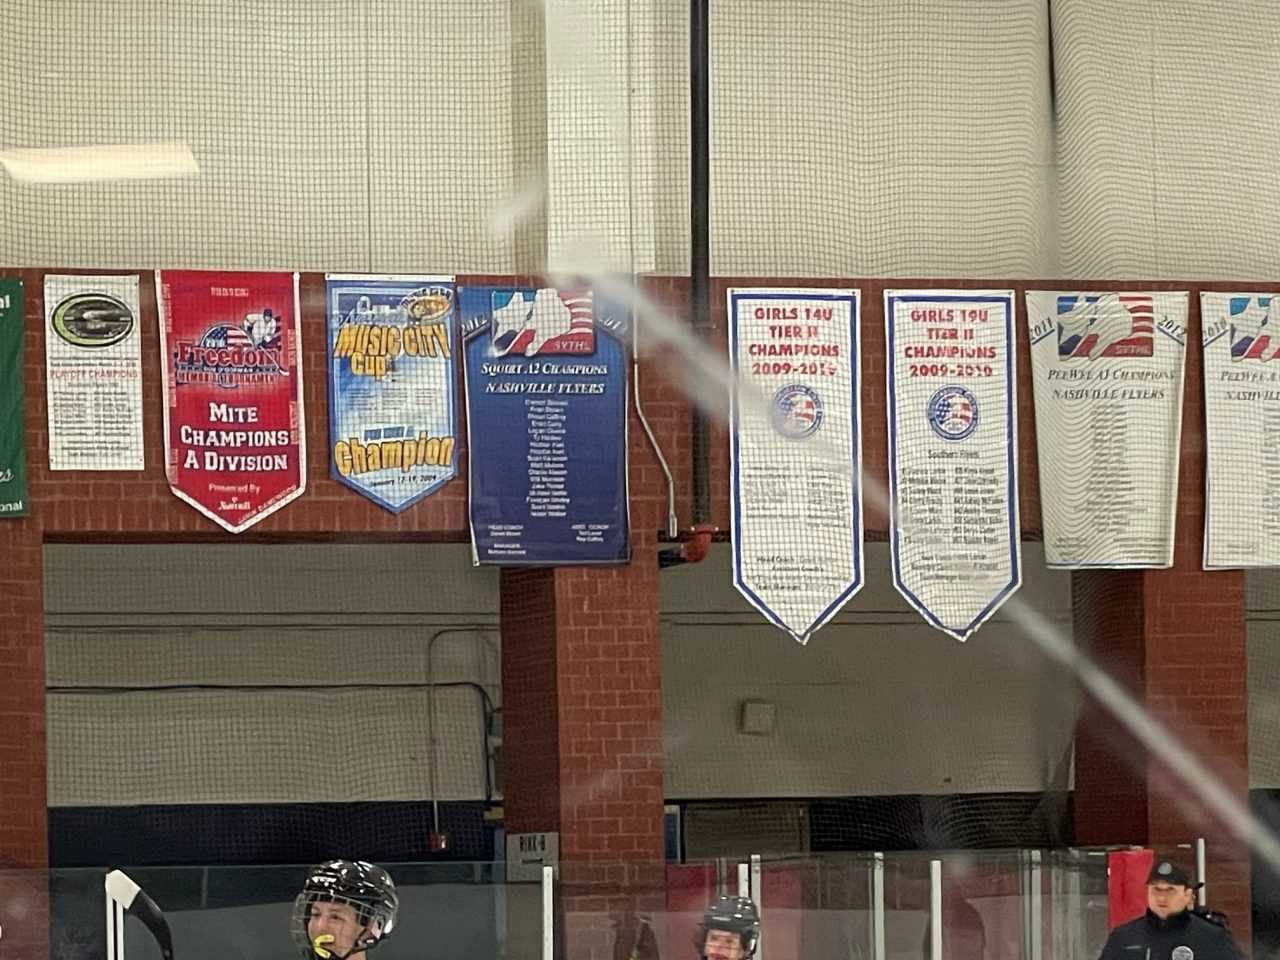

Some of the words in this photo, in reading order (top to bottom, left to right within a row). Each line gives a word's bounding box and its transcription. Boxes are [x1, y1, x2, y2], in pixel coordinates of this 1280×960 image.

[754, 307, 798, 320] GIRLS
[805, 308, 832, 320] 14U
[911, 310, 954, 323] GIRLS
[769, 326, 802, 338] TIER
[926, 328, 957, 339] TIER
[334, 324, 401, 357] MUSIC
[403, 324, 451, 358] CITY
[177, 341, 280, 367] Freedom
[749, 344, 840, 357] CHAMPIONS
[904, 346, 996, 358] CHAMPIONS
[184, 450, 199, 470] A
[335, 431, 455, 477] Champion
